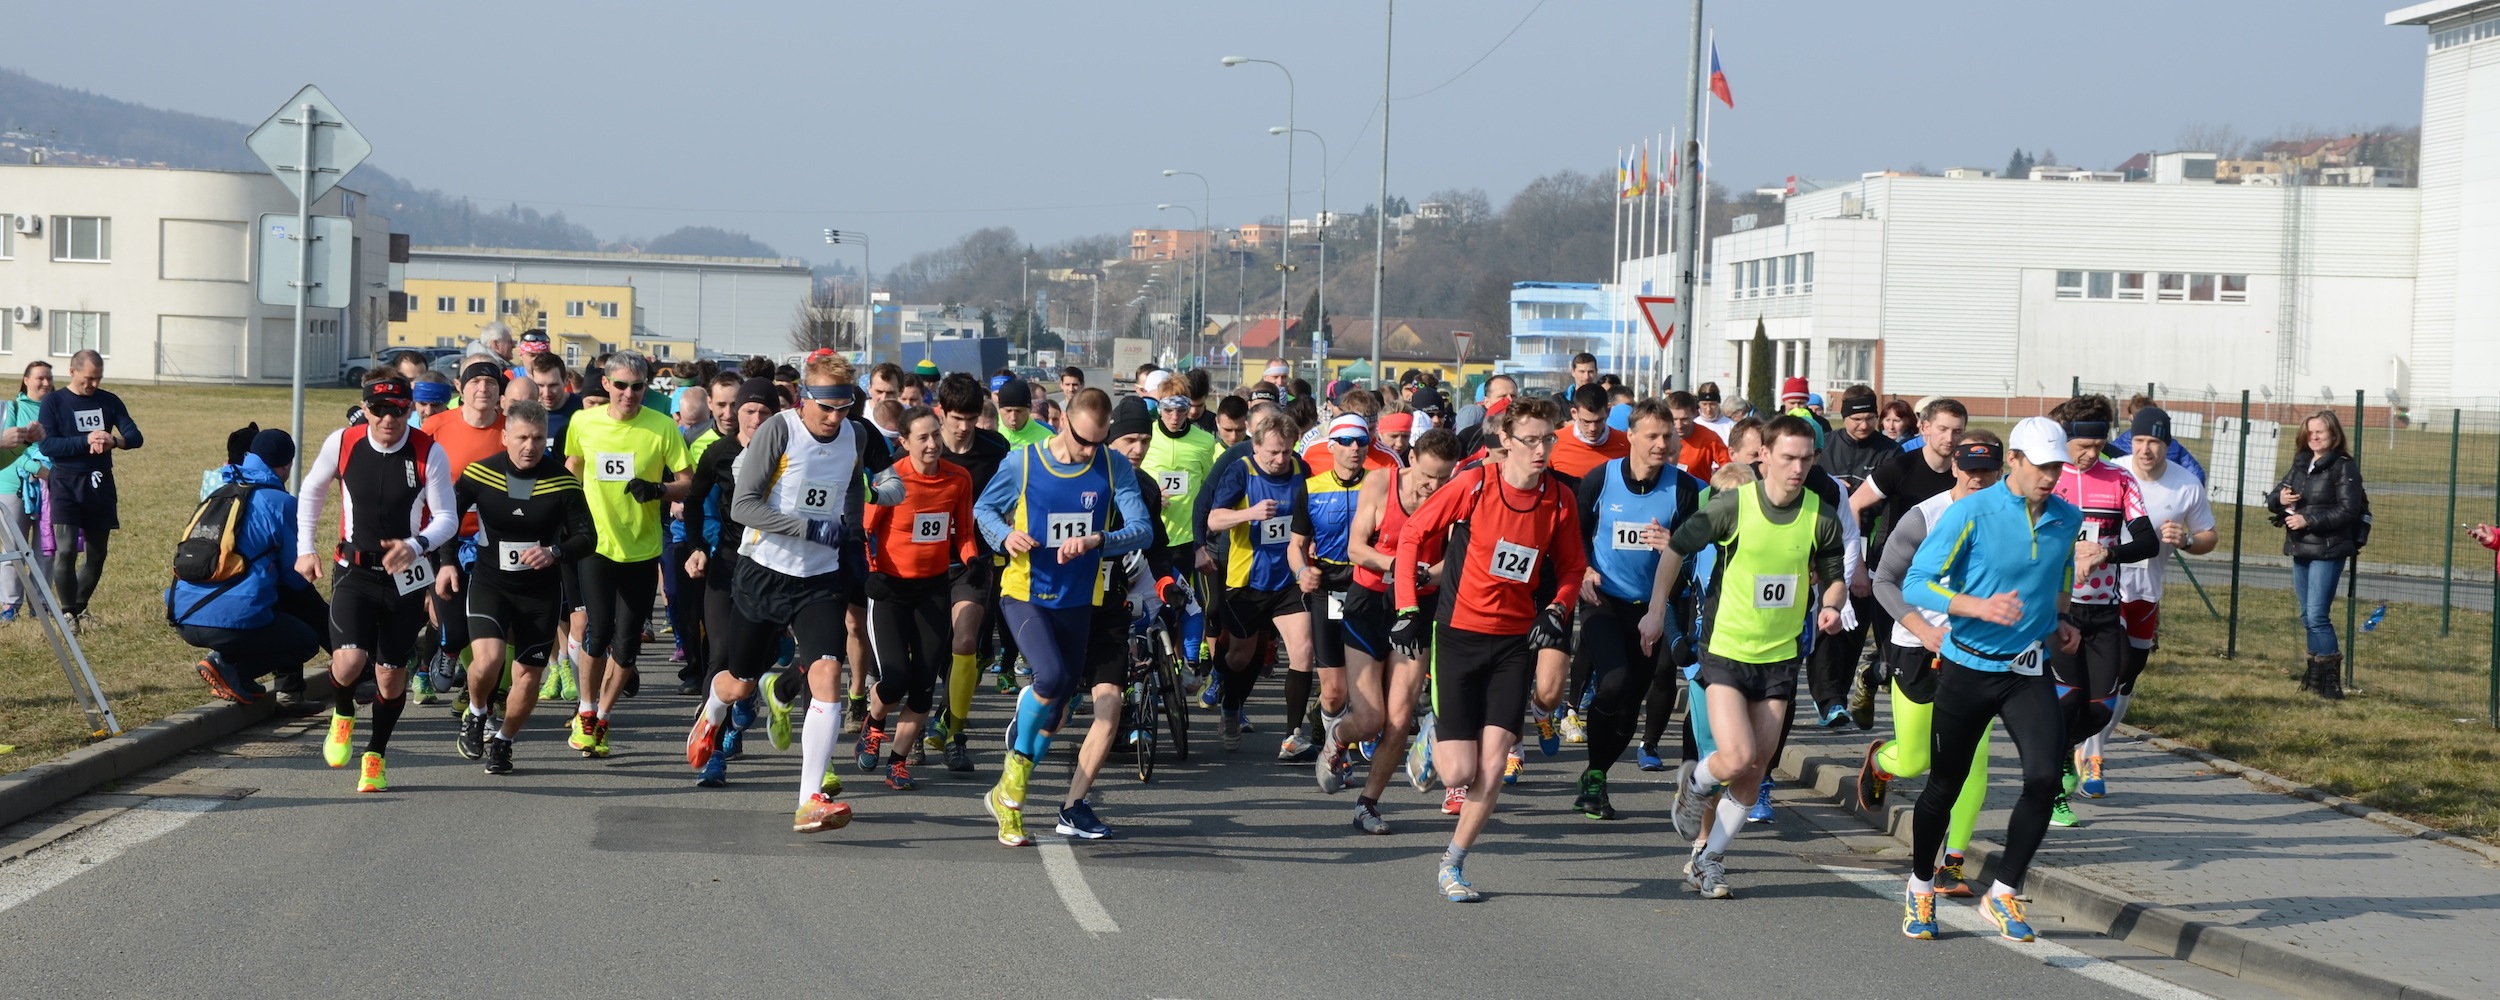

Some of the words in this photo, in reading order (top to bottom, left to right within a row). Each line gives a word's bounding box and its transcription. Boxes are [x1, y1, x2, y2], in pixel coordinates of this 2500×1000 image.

[78, 415, 101, 428] 149
[605, 460, 625, 475] 65
[1165, 477, 1181, 490] 75
[805, 488, 828, 508] 83
[921, 520, 941, 536] 89
[1052, 522, 1087, 540] 113
[1269, 523, 1286, 539] 51
[2076, 530, 2088, 542] 4
[508, 550, 521, 565] 9
[1497, 551, 1530, 575] 124
[402, 565, 425, 586] 30
[1763, 583, 1786, 602] 60
